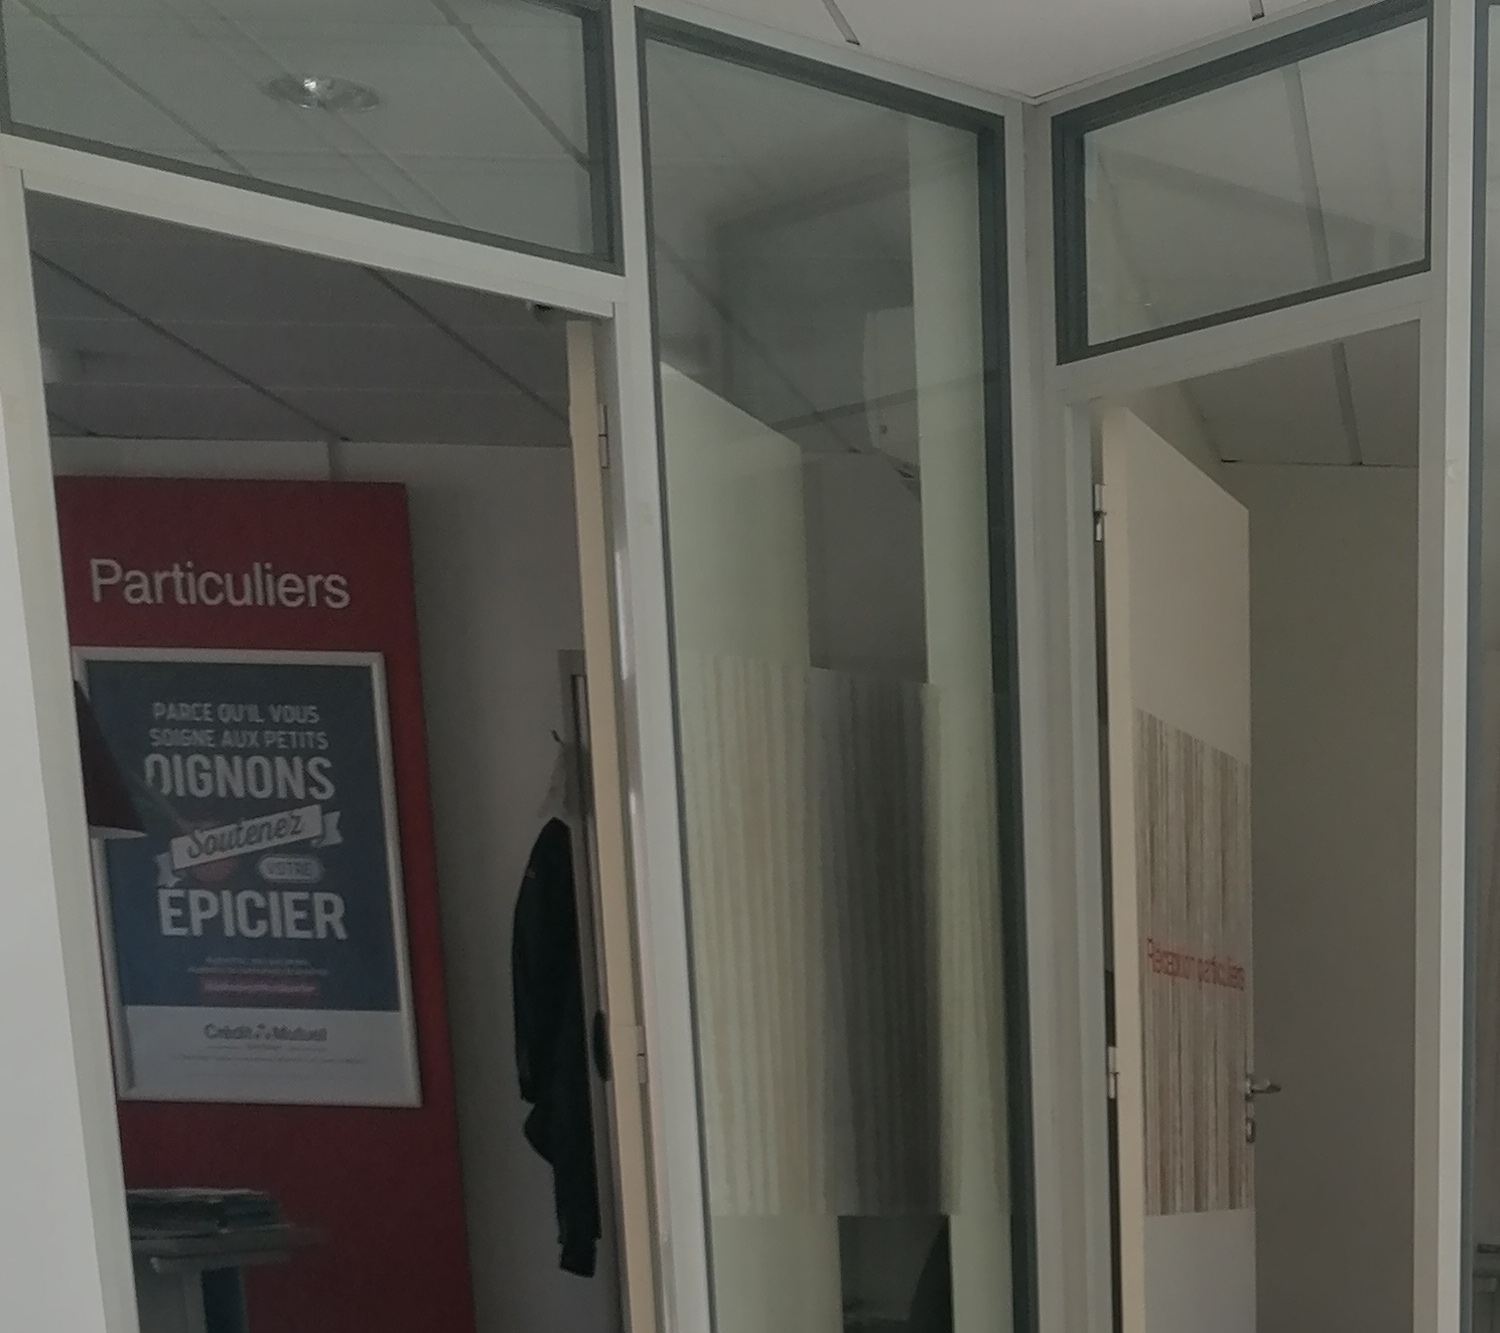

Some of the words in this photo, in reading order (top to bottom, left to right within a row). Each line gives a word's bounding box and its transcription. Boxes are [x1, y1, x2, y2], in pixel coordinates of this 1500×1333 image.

[89, 558, 351, 609] Particuliers
[152, 702, 214, 722] PARCE
[268, 704, 320, 724] VOUS
[150, 728, 215, 747] SOIGNE
[220, 730, 260, 748] AUX
[263, 730, 329, 750] PETITS
[143, 752, 336, 800] OIGNONS
[187, 812, 304, 859] Soutenez
